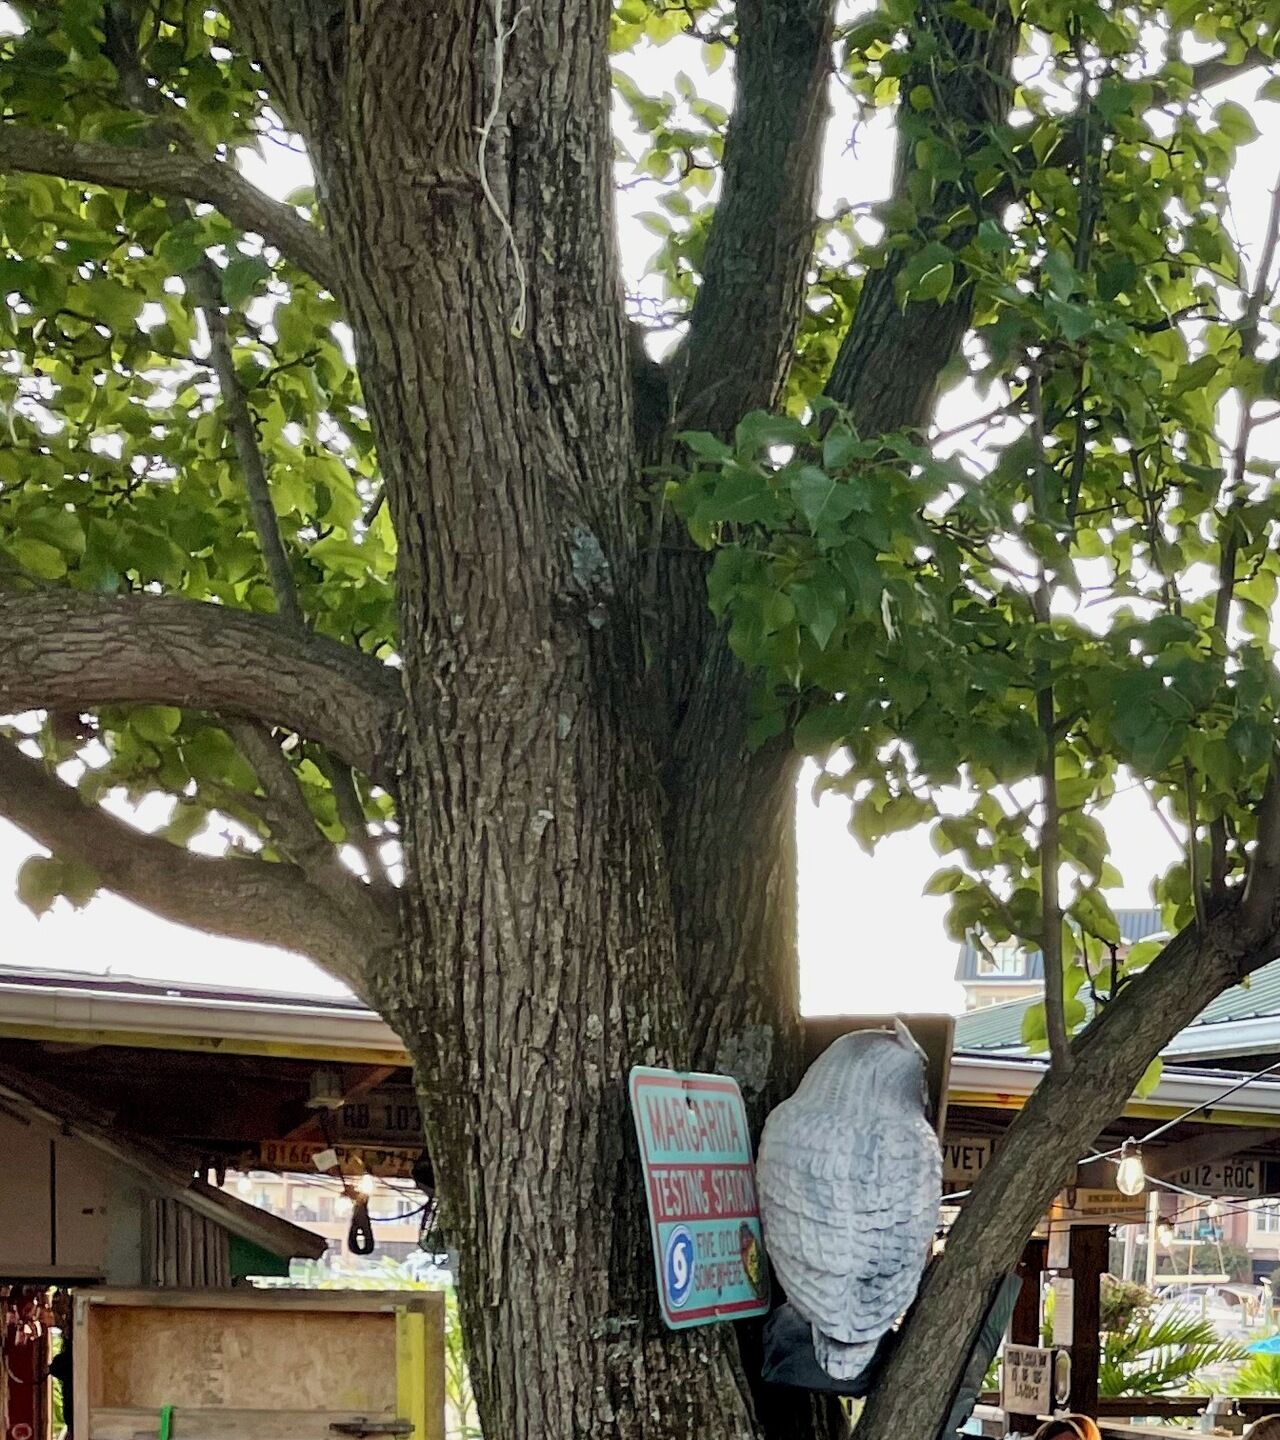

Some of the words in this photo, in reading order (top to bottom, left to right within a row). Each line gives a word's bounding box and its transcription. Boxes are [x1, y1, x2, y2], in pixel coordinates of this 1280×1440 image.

[646, 1095, 743, 1152] MARGARITA
[651, 1169, 709, 1217] TESTING
[711, 1169, 757, 1214] STATION
[694, 1260, 744, 1291] SOMEWHERE
